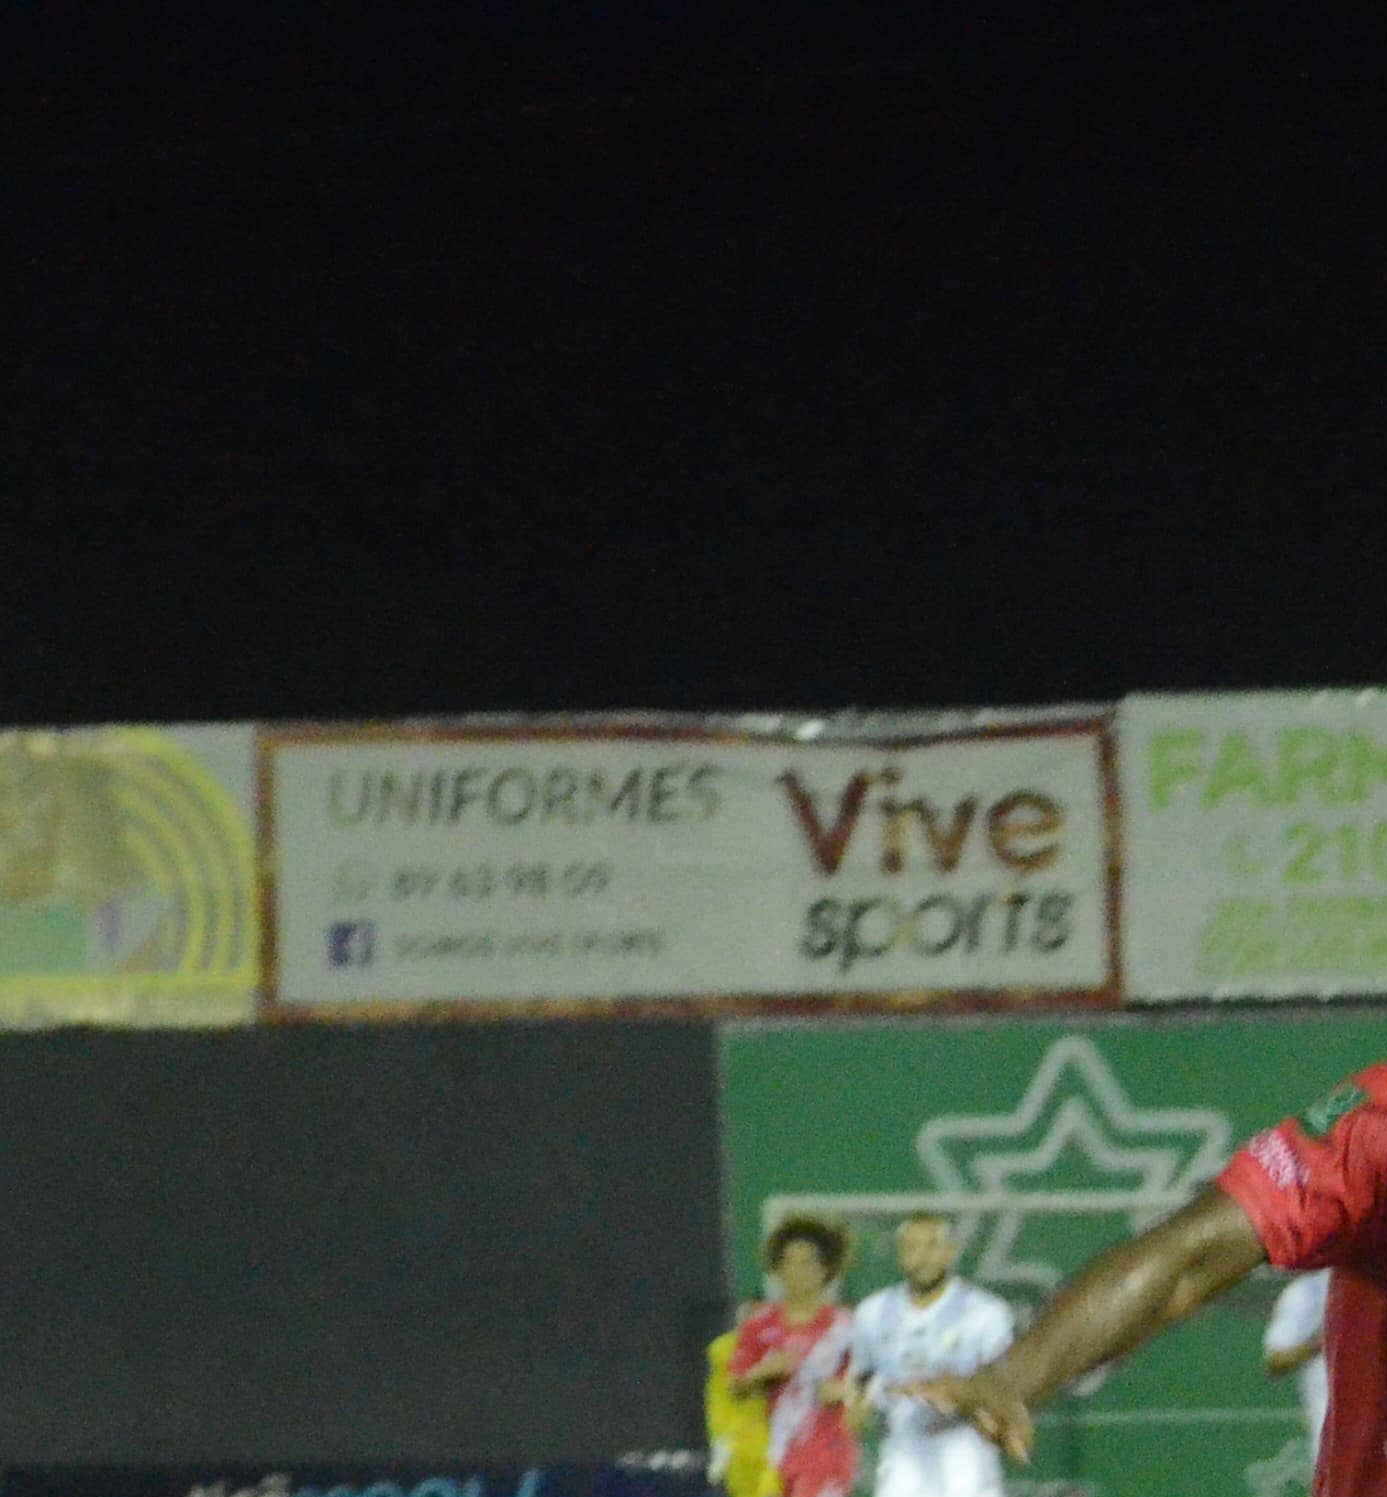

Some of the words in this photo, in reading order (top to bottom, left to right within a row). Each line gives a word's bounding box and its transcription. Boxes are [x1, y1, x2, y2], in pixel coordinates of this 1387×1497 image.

[326, 762, 722, 827] UNIFORMES
[777, 765, 1066, 876] Vive
[800, 890, 1074, 974] sports
